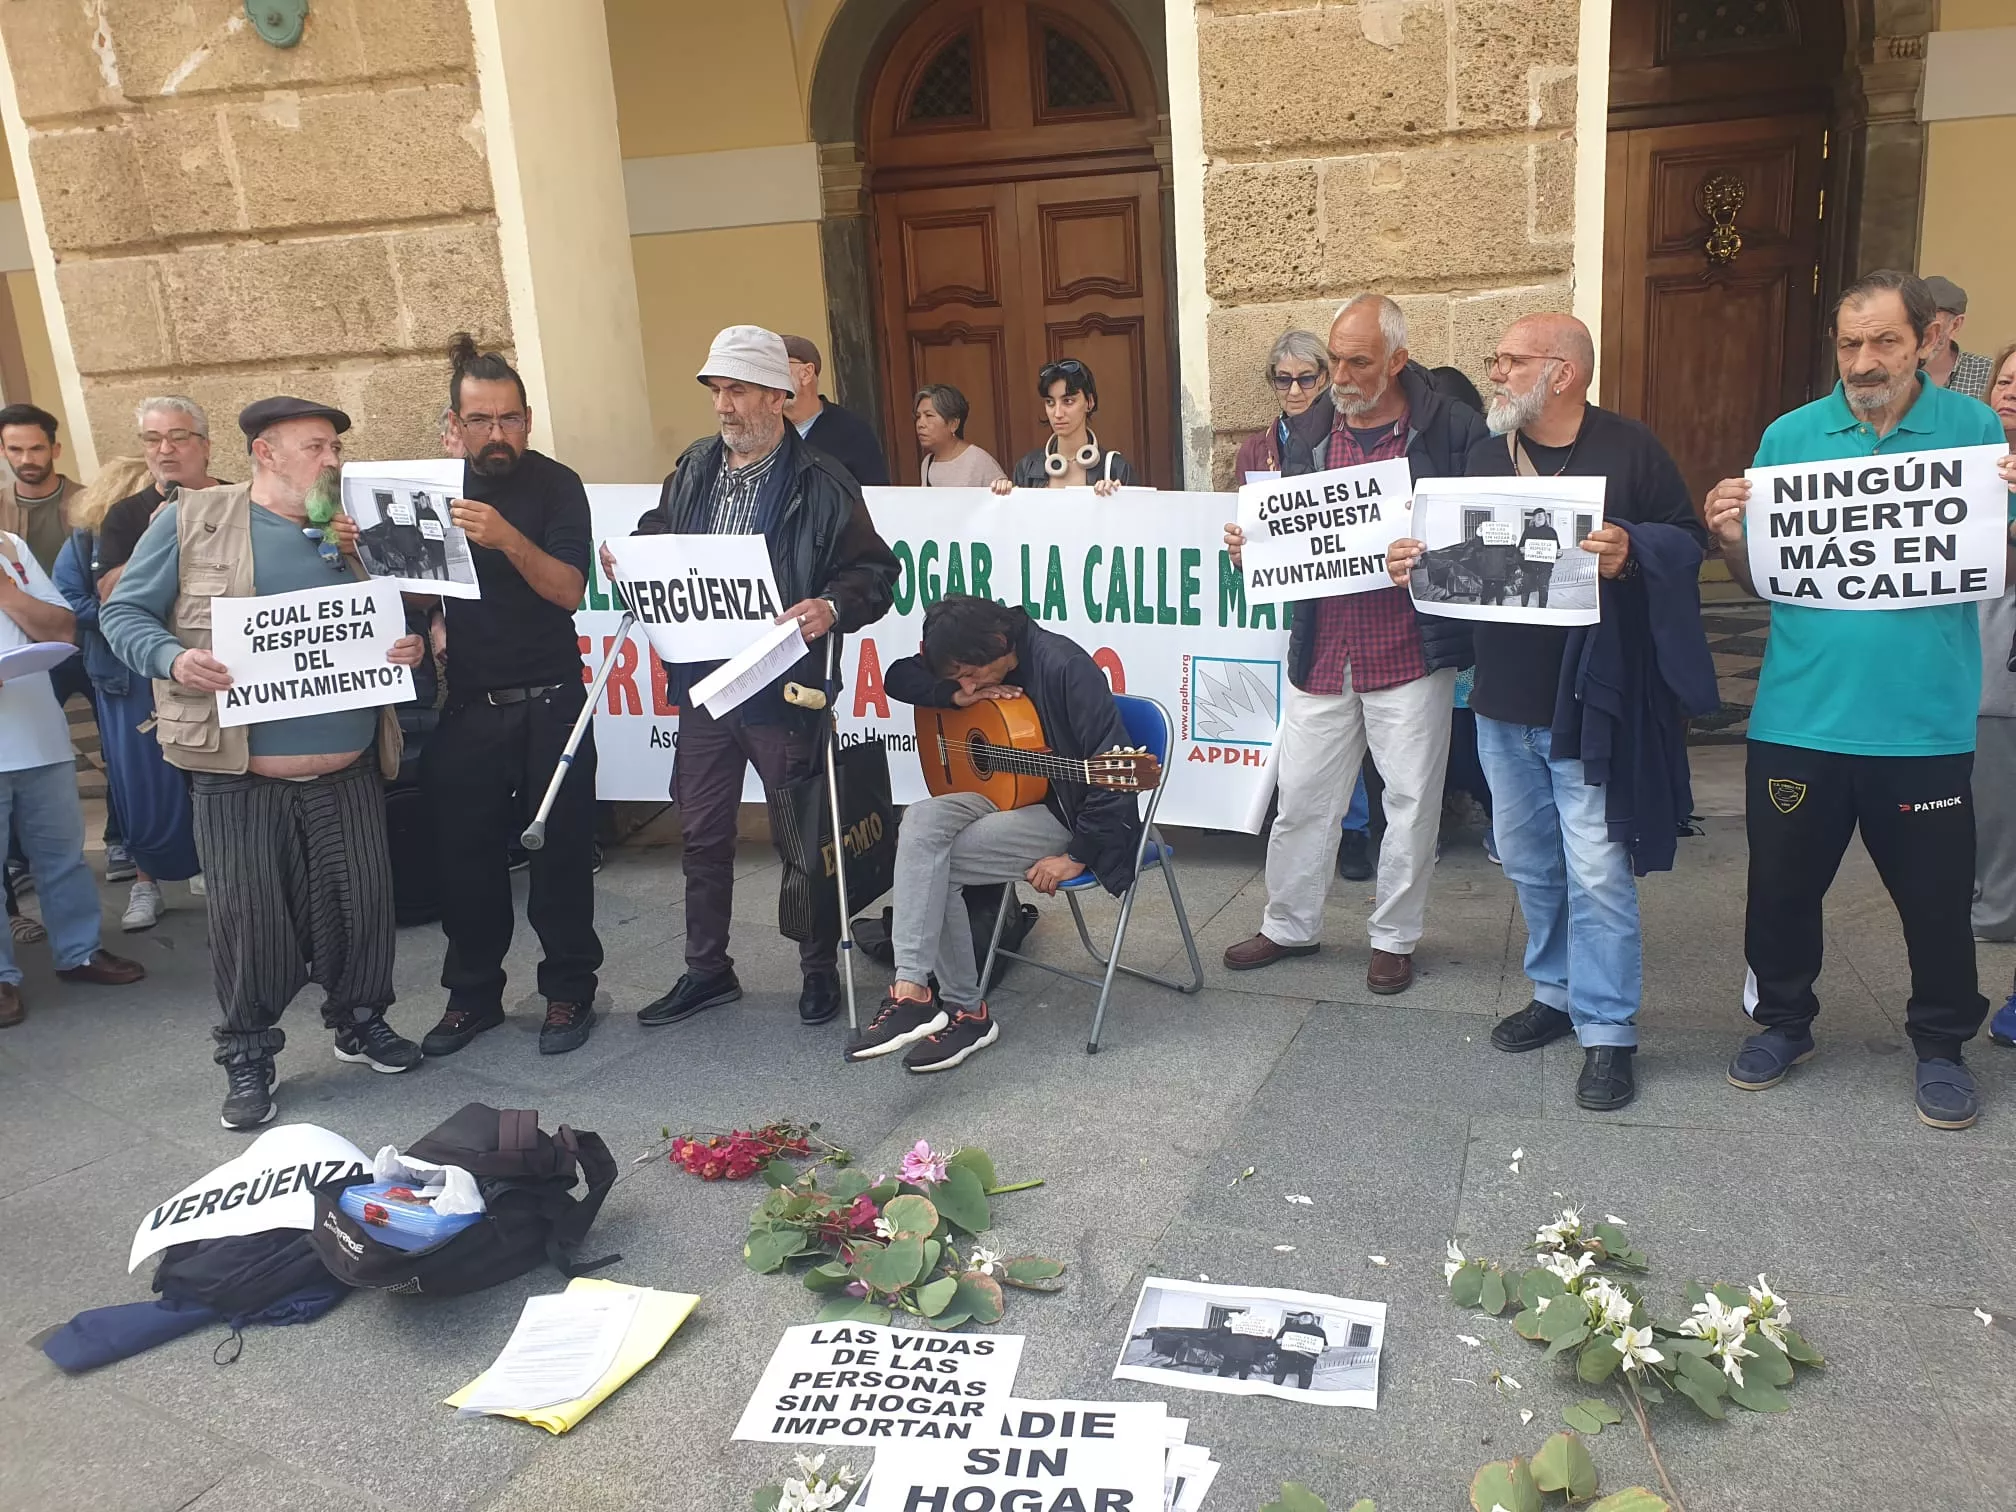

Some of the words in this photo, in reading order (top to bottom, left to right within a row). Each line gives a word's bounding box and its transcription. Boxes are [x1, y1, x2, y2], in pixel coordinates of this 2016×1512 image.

[1774, 457, 1962, 504] NINGÚN
[1258, 489, 1319, 521] ¿CUAL
[1324, 483, 1349, 504] ES
[1355, 478, 1382, 499] LA
[1268, 503, 1382, 536] RESPUESTA
[1770, 497, 1968, 538] MUERTO
[1310, 534, 1346, 555] DEL
[1780, 536, 1876, 570] MÁS
[1894, 534, 1956, 564] EN
[1021, 544, 1068, 621] LA
[1083, 544, 1201, 626] CALLE
[1251, 553, 1386, 588] AYUNTAMIENT
[1769, 576, 1823, 600] LA
[1837, 568, 1987, 600] CALLE
[619, 568, 777, 624] VERGÜENZA
[243, 605, 311, 635] ¿CUAL
[318, 600, 343, 619] ES
[351, 596, 376, 615] LA
[252, 621, 374, 653] RESPUESTA
[294, 649, 334, 672] DEL
[226, 665, 403, 708] AYUNTAMIENTO?
[1180, 654, 1191, 740] www.apdha.org
[1187, 745, 1268, 767] APDH
[1914, 796, 1962, 812] PATRICK
[151, 1161, 365, 1231] VERGÜENZA
[810, 1328, 877, 1344] LAS
[891, 1334, 995, 1356] VIDAS
[831, 1349, 879, 1366] DE
[889, 1355, 959, 1374] LAS
[789, 1371, 987, 1397] PERSONAS
[775, 1394, 839, 1411] SIN
[850, 1393, 985, 1417] HOGAR
[771, 1416, 972, 1439] IMPORTAN
[963, 1447, 1069, 1478] SIN
[903, 1485, 1134, 1512] HOGAR
